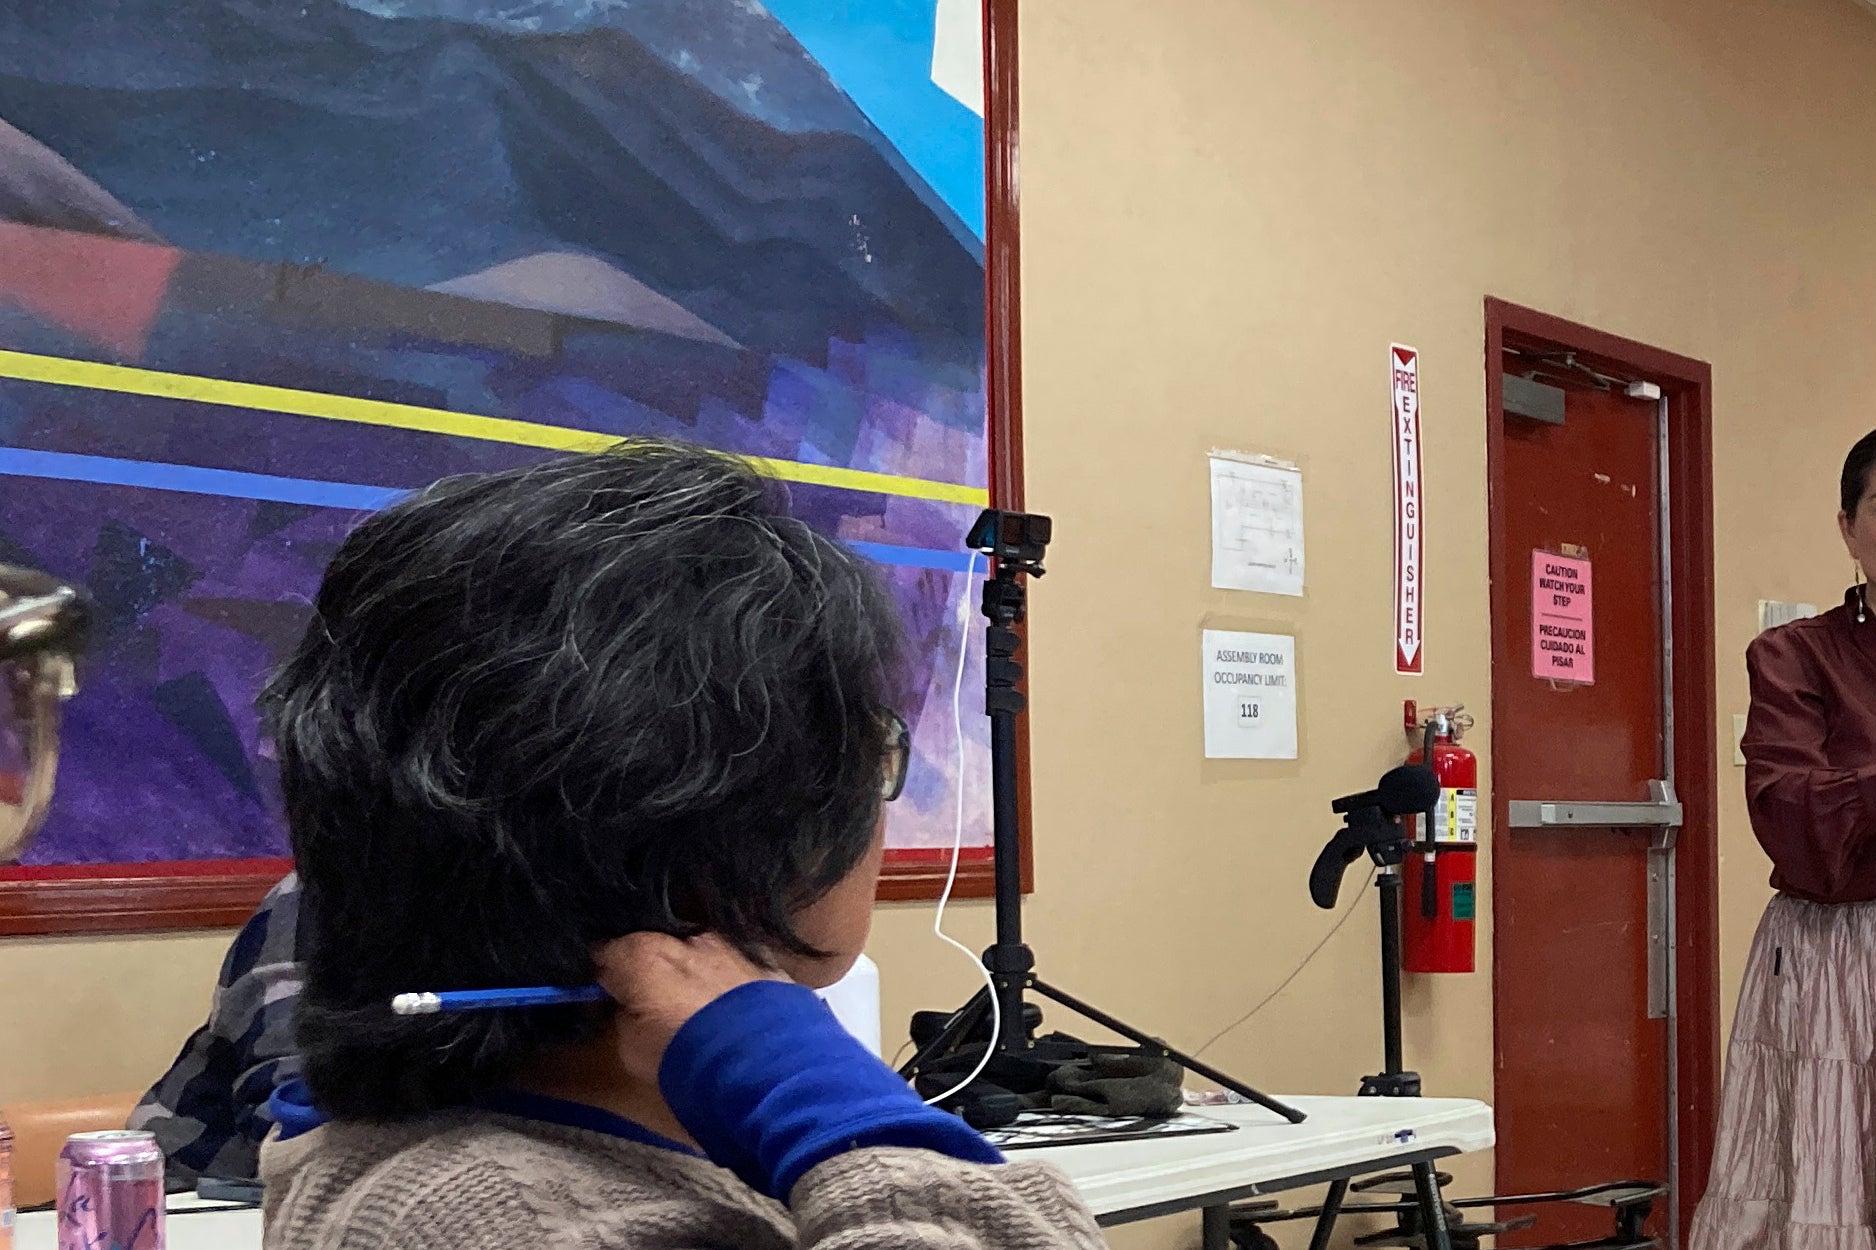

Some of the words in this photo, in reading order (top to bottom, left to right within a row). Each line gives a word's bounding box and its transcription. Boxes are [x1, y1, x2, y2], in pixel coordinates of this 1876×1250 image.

[1395, 370, 1416, 393] FIRE
[1402, 396, 1416, 645] EXTINGUISHER
[1545, 563, 1578, 580] CAUTION
[1539, 578, 1565, 592] WATCH
[1565, 582, 1585, 595] YOUR
[1553, 594, 1571, 607] STEP
[1539, 624, 1586, 641] PRECAUCION
[1540, 639, 1574, 654] CUIDADO
[1575, 643, 1586, 655] AL
[1216, 650, 1257, 664] ASSEMBLY
[1259, 653, 1284, 665] ROOM
[1552, 655, 1573, 668] PISAR
[1214, 671, 1263, 687] OCCUPANCY
[1241, 703, 1259, 718] 118
